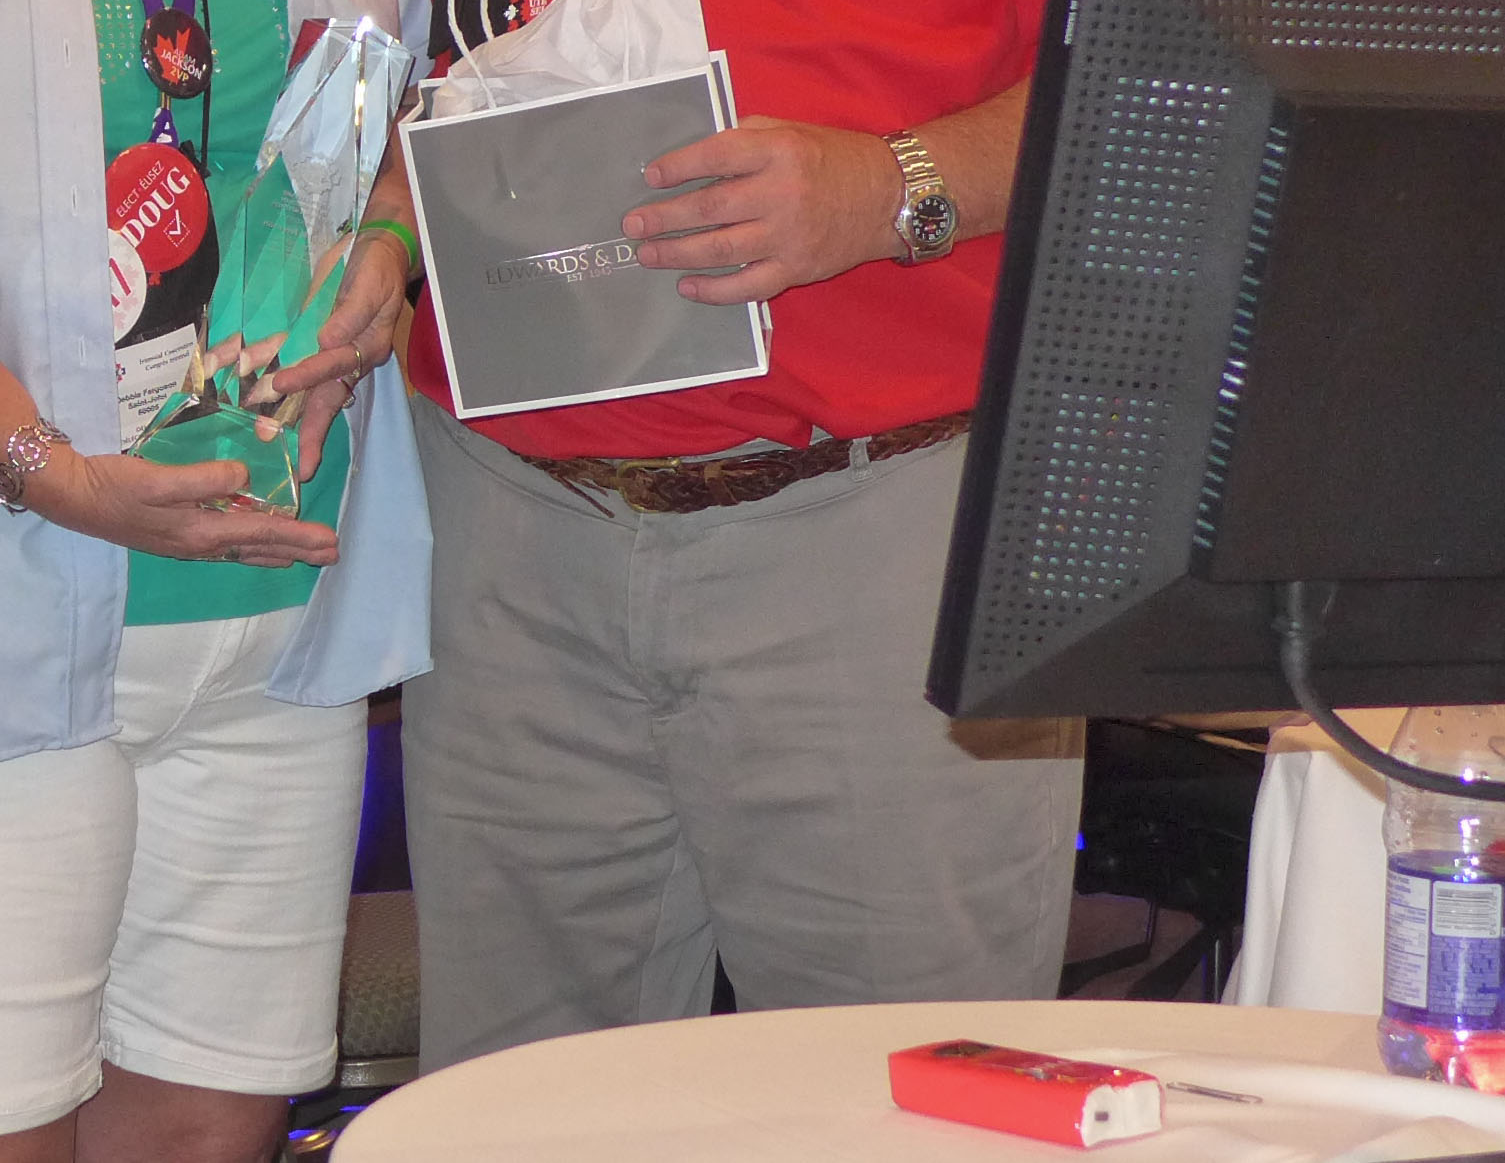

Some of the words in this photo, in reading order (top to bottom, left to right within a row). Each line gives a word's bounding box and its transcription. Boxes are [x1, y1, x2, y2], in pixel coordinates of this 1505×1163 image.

[161, 48, 203, 80] JACKSON
[170, 66, 189, 82] 2VP
[116, 189, 140, 218] ELECT
[120, 166, 191, 248] DOUG
[486, 251, 589, 285] EDWARDS
[595, 249, 613, 267] &
[615, 243, 637, 263] D
